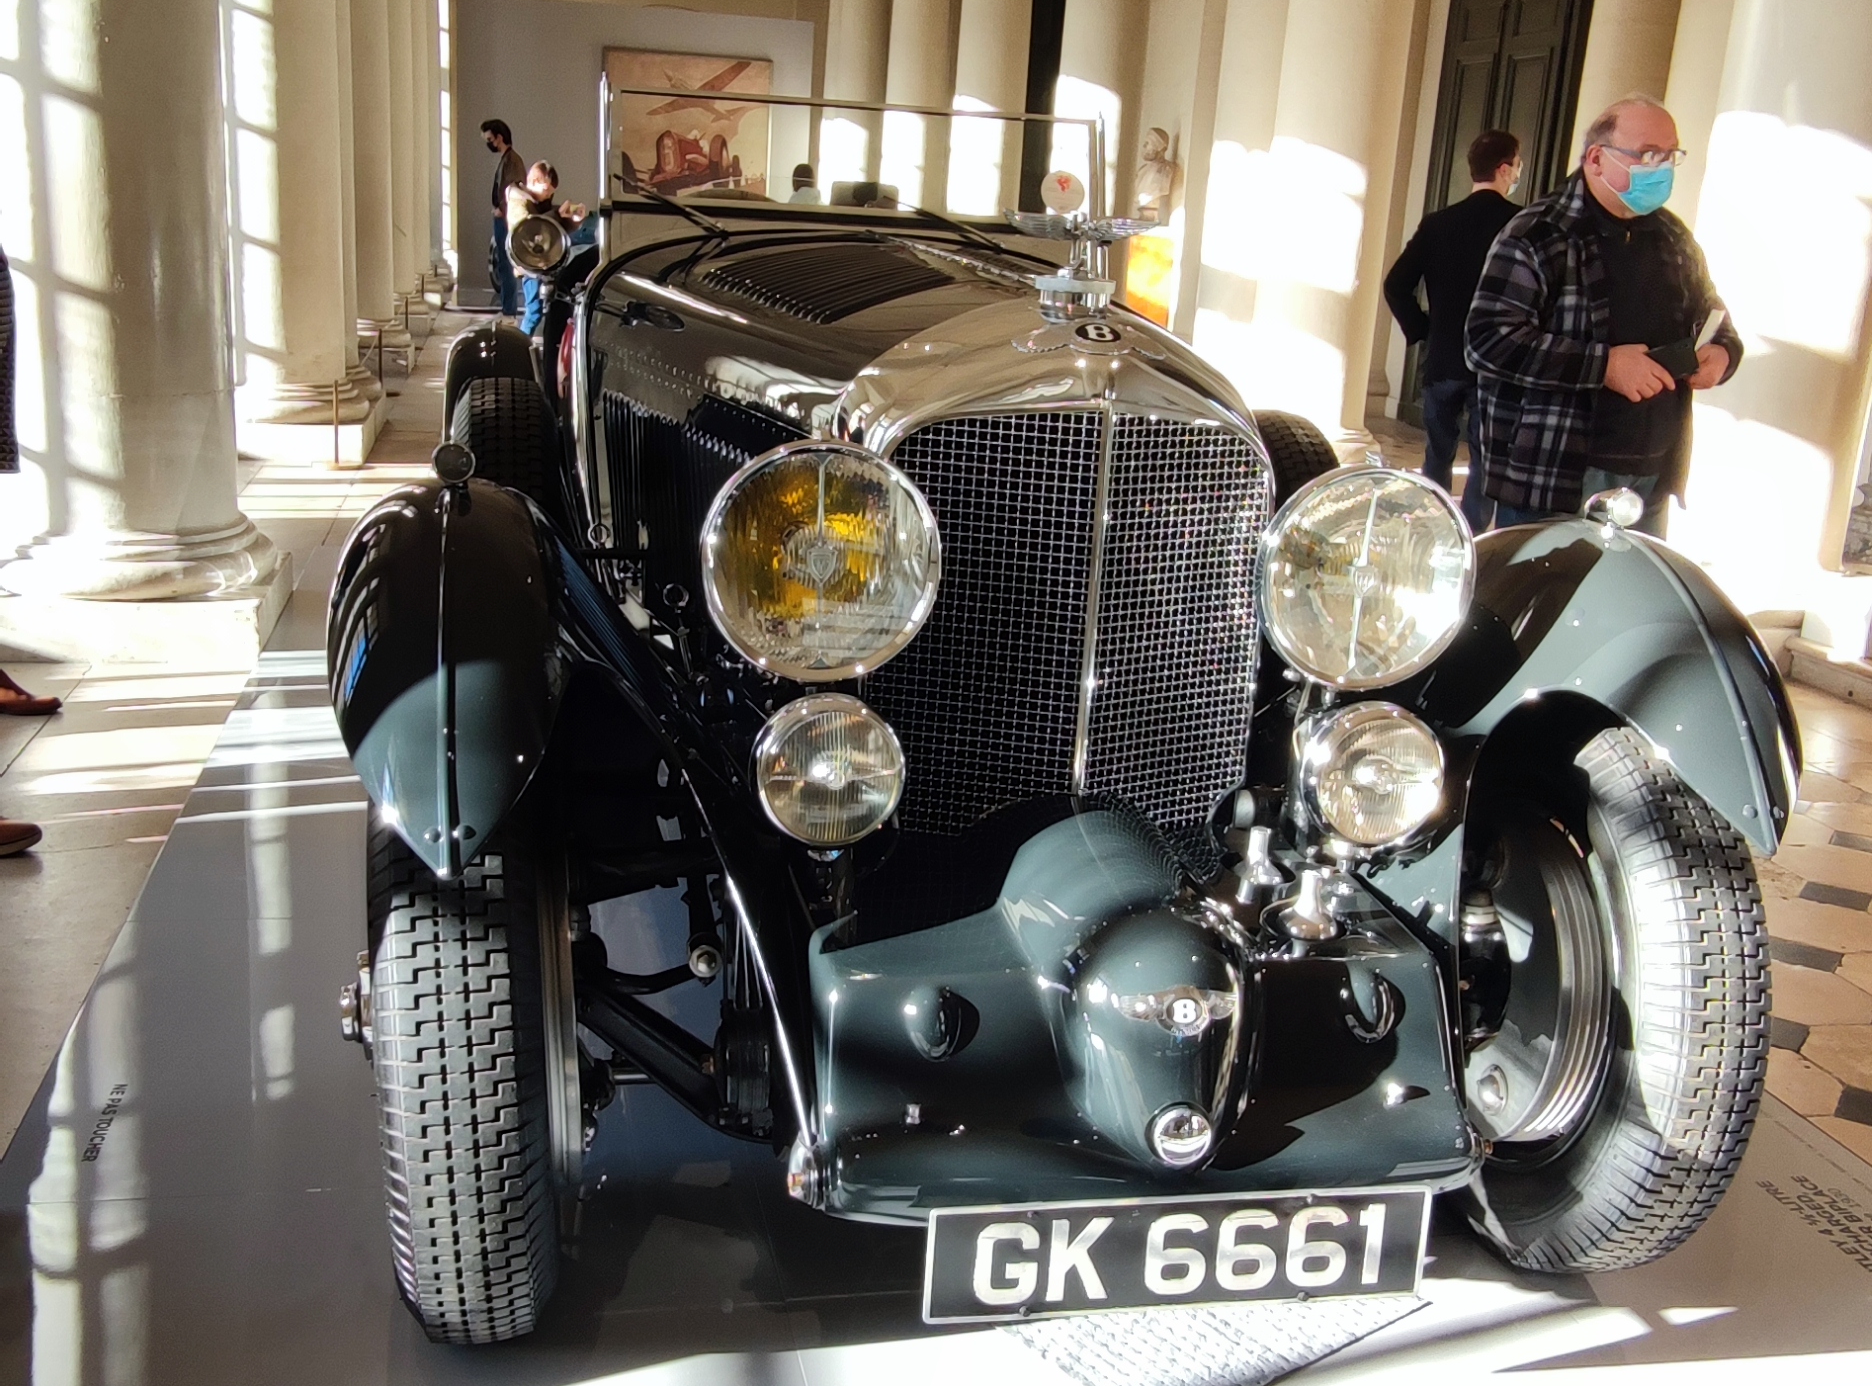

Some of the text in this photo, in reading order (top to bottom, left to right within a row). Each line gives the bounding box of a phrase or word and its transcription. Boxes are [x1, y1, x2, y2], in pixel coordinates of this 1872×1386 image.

[1084, 324, 1116, 342] B
[1172, 998, 1197, 1024] B
[81, 1083, 128, 1162] NE PAS TOUCHER
[1790, 1175, 1864, 1223] BIPLACE
[972, 1203, 1387, 1306] GK 6661
[1829, 1239, 1872, 1273] TLEY
